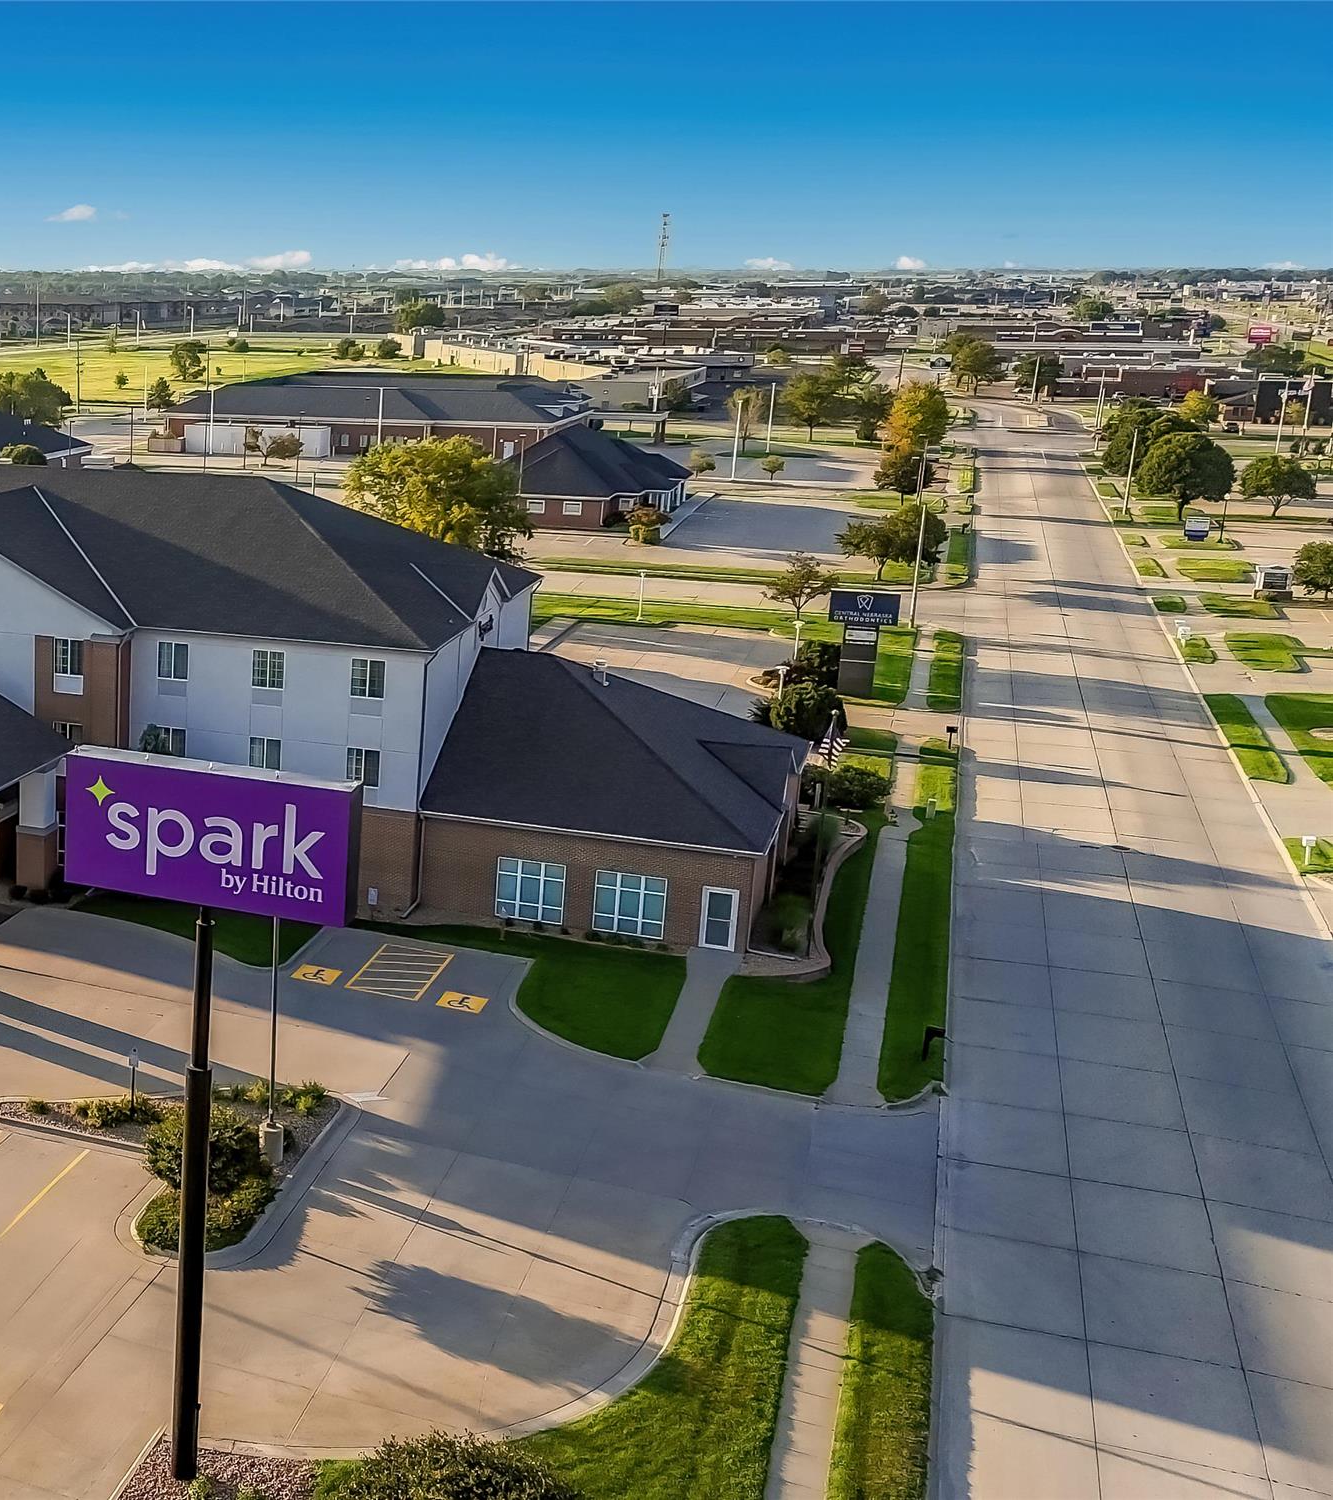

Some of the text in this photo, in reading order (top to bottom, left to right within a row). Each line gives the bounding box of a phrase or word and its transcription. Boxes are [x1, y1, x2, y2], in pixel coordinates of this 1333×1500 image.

[105, 802, 326, 880] spark
[220, 868, 323, 903] by Hilton
